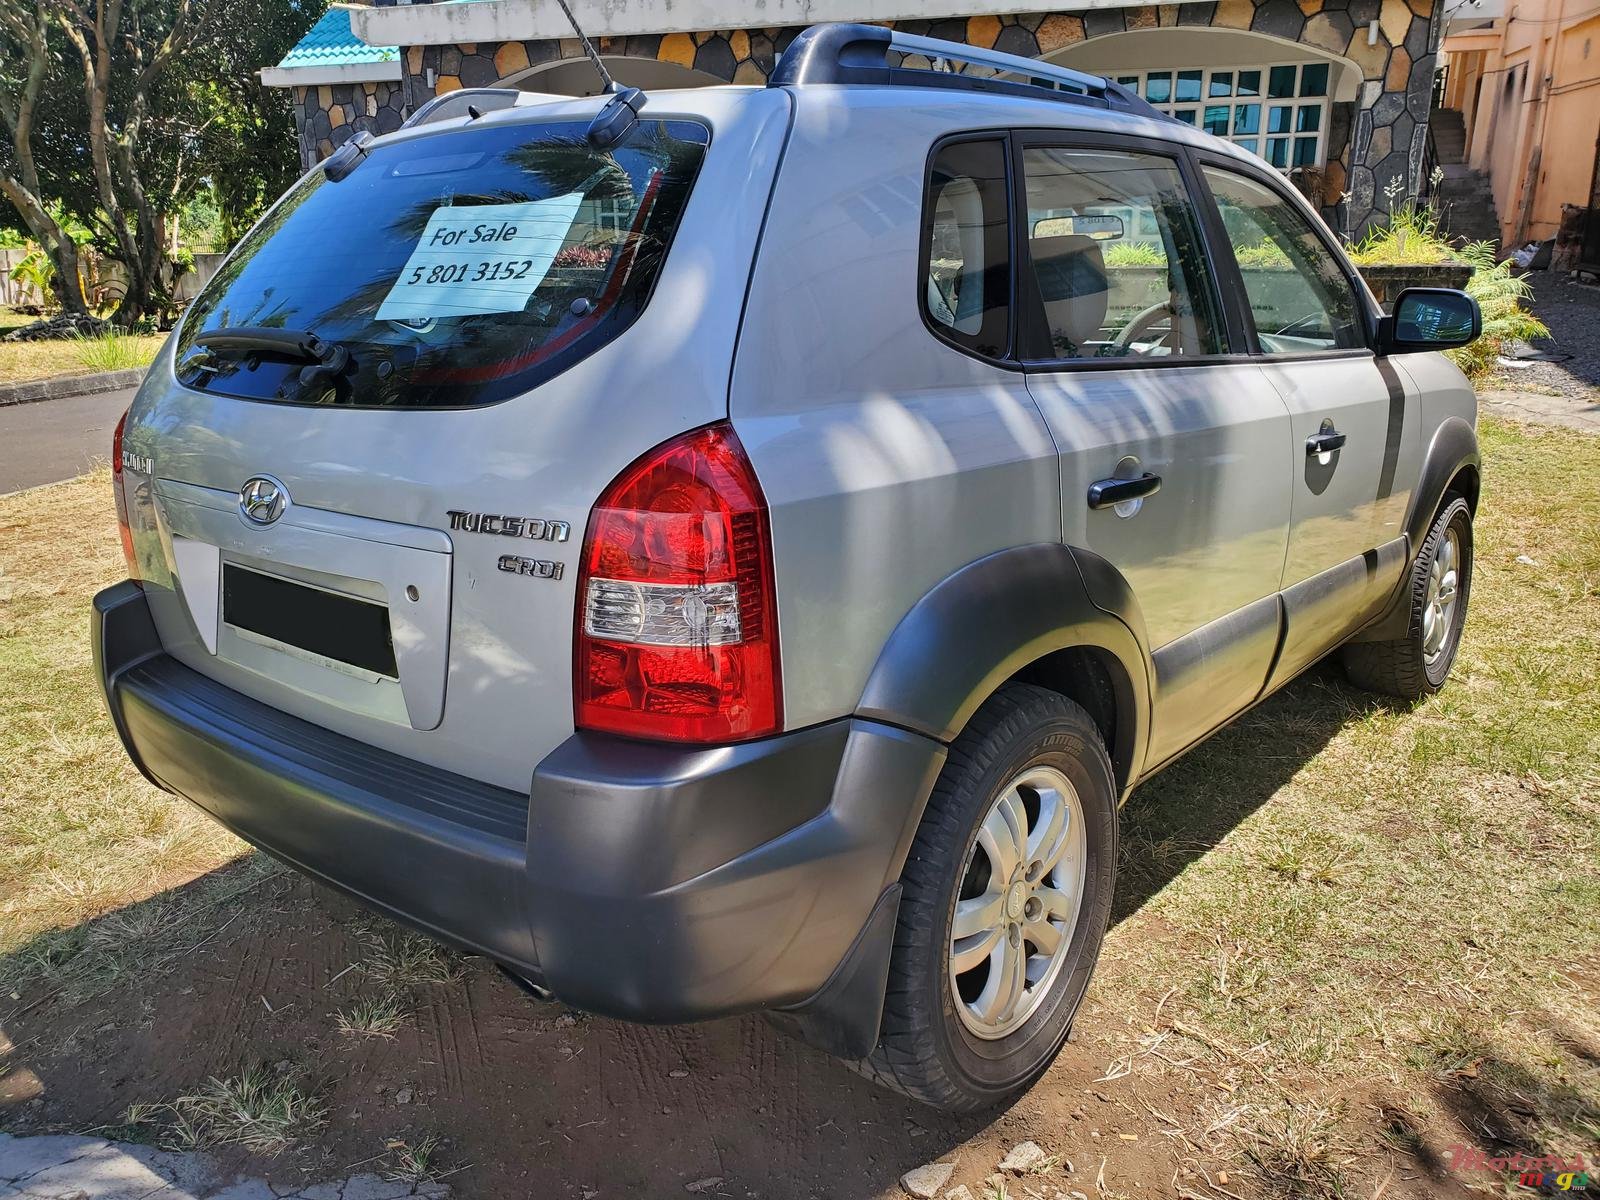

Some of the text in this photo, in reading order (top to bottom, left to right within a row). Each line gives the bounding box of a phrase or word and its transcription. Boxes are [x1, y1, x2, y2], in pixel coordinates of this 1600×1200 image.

[429, 221, 518, 247] For Sale
[407, 259, 533, 285] 5 801 3152
[446, 510, 571, 543] TUCSON
